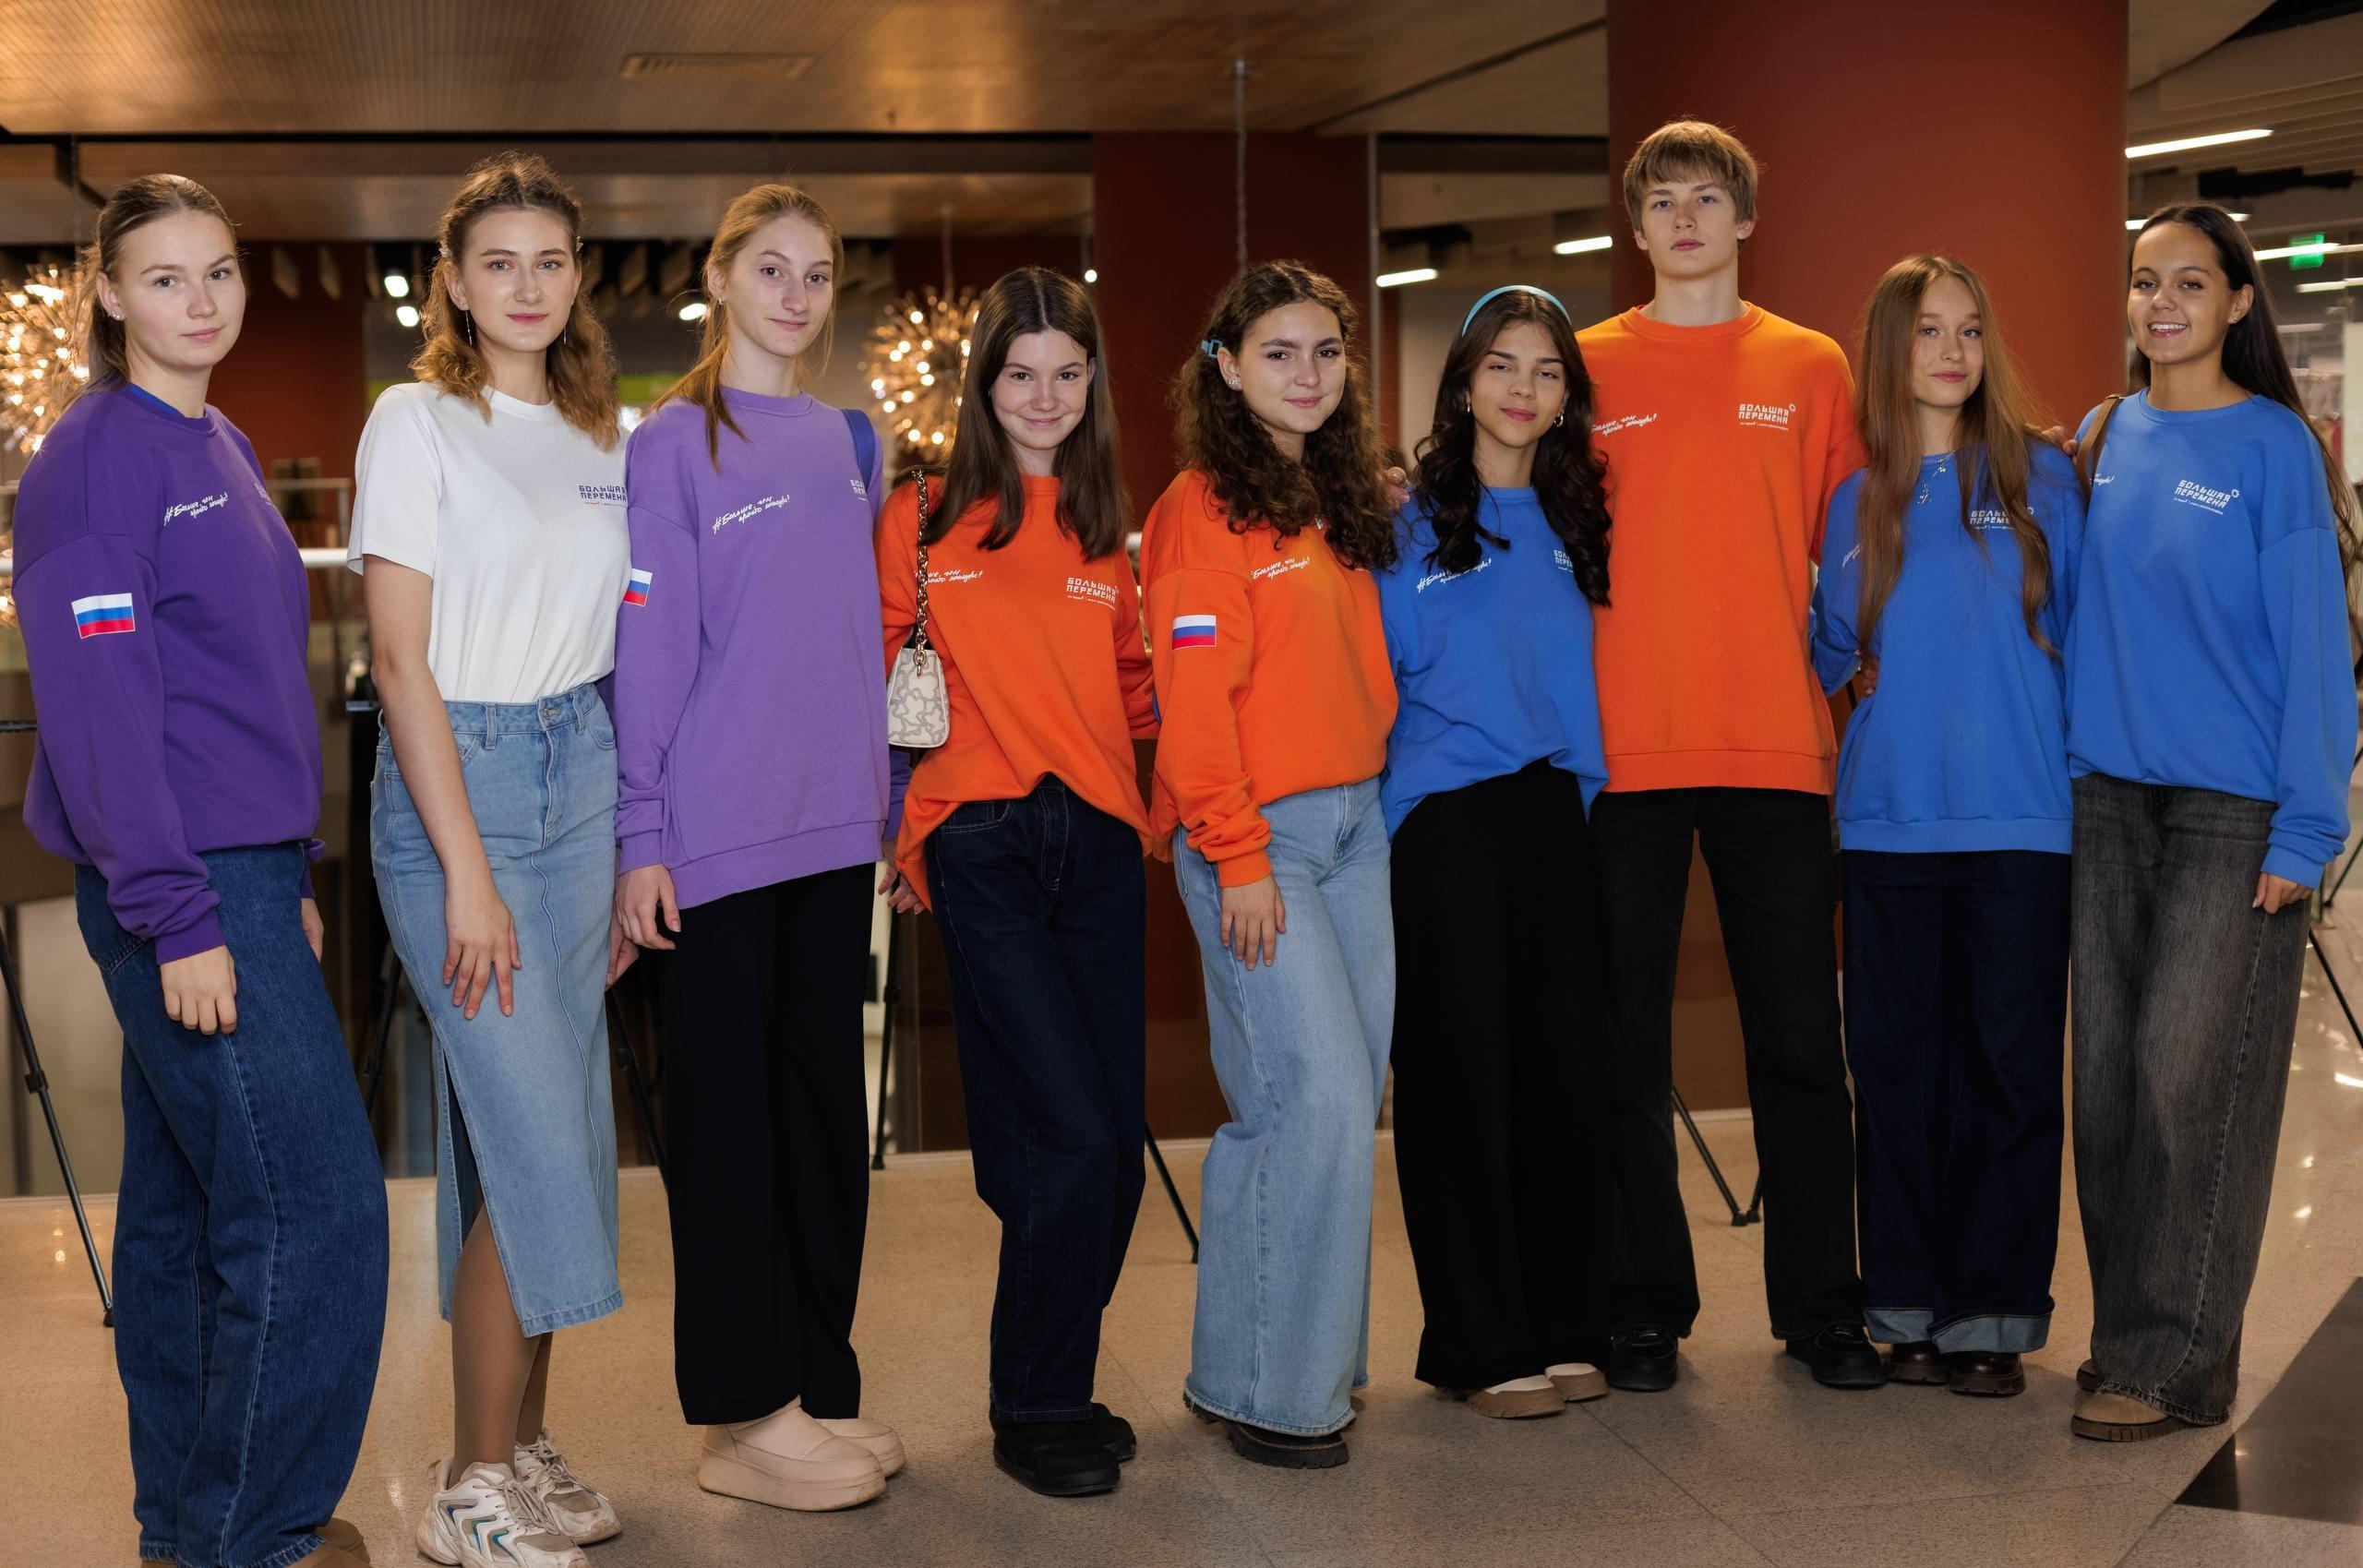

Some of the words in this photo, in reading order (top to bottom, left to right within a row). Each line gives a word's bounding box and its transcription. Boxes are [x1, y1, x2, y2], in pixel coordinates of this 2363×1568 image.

[1738, 412, 1788, 425] ПЕРЕМЕНА
[1739, 403, 1789, 416] БОЛЬШАЯ
[581, 492, 627, 502] ПЕРЕМЕНА
[2175, 486, 2227, 509] ПЕРЕМЕНА
[2178, 479, 2231, 502] БОЛЬШАЯ
[1066, 585, 1115, 604] ПЕРЕМЕНА
[1067, 577, 1116, 596] БОЛЬШАЯ
